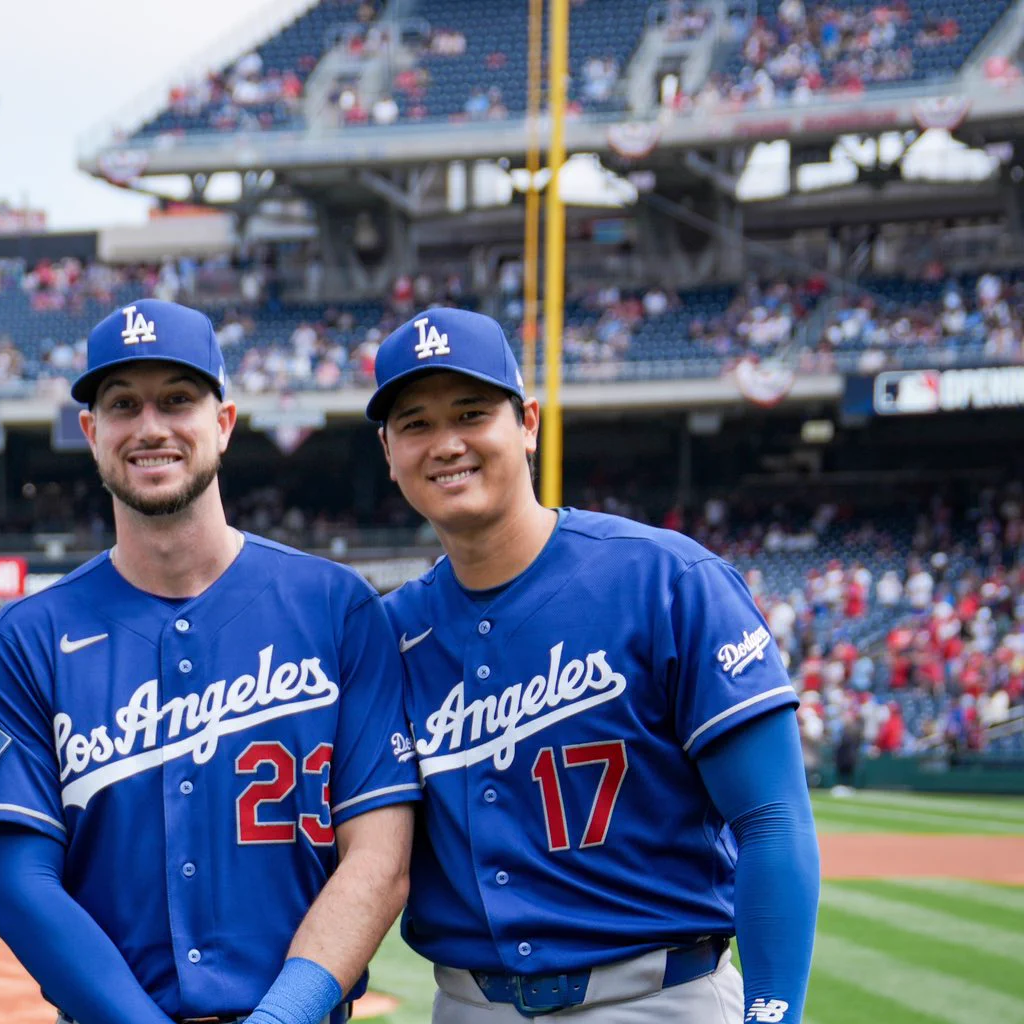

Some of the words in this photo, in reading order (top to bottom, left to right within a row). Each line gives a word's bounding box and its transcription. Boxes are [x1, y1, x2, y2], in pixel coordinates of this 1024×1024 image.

[121, 305, 156, 345] LA
[414, 317, 450, 359] LA
[53, 712, 114, 782] Los
[114, 644, 339, 764] Angeles
[416, 641, 626, 771] Angeles
[235, 740, 335, 846] 23
[531, 739, 628, 852] 17
